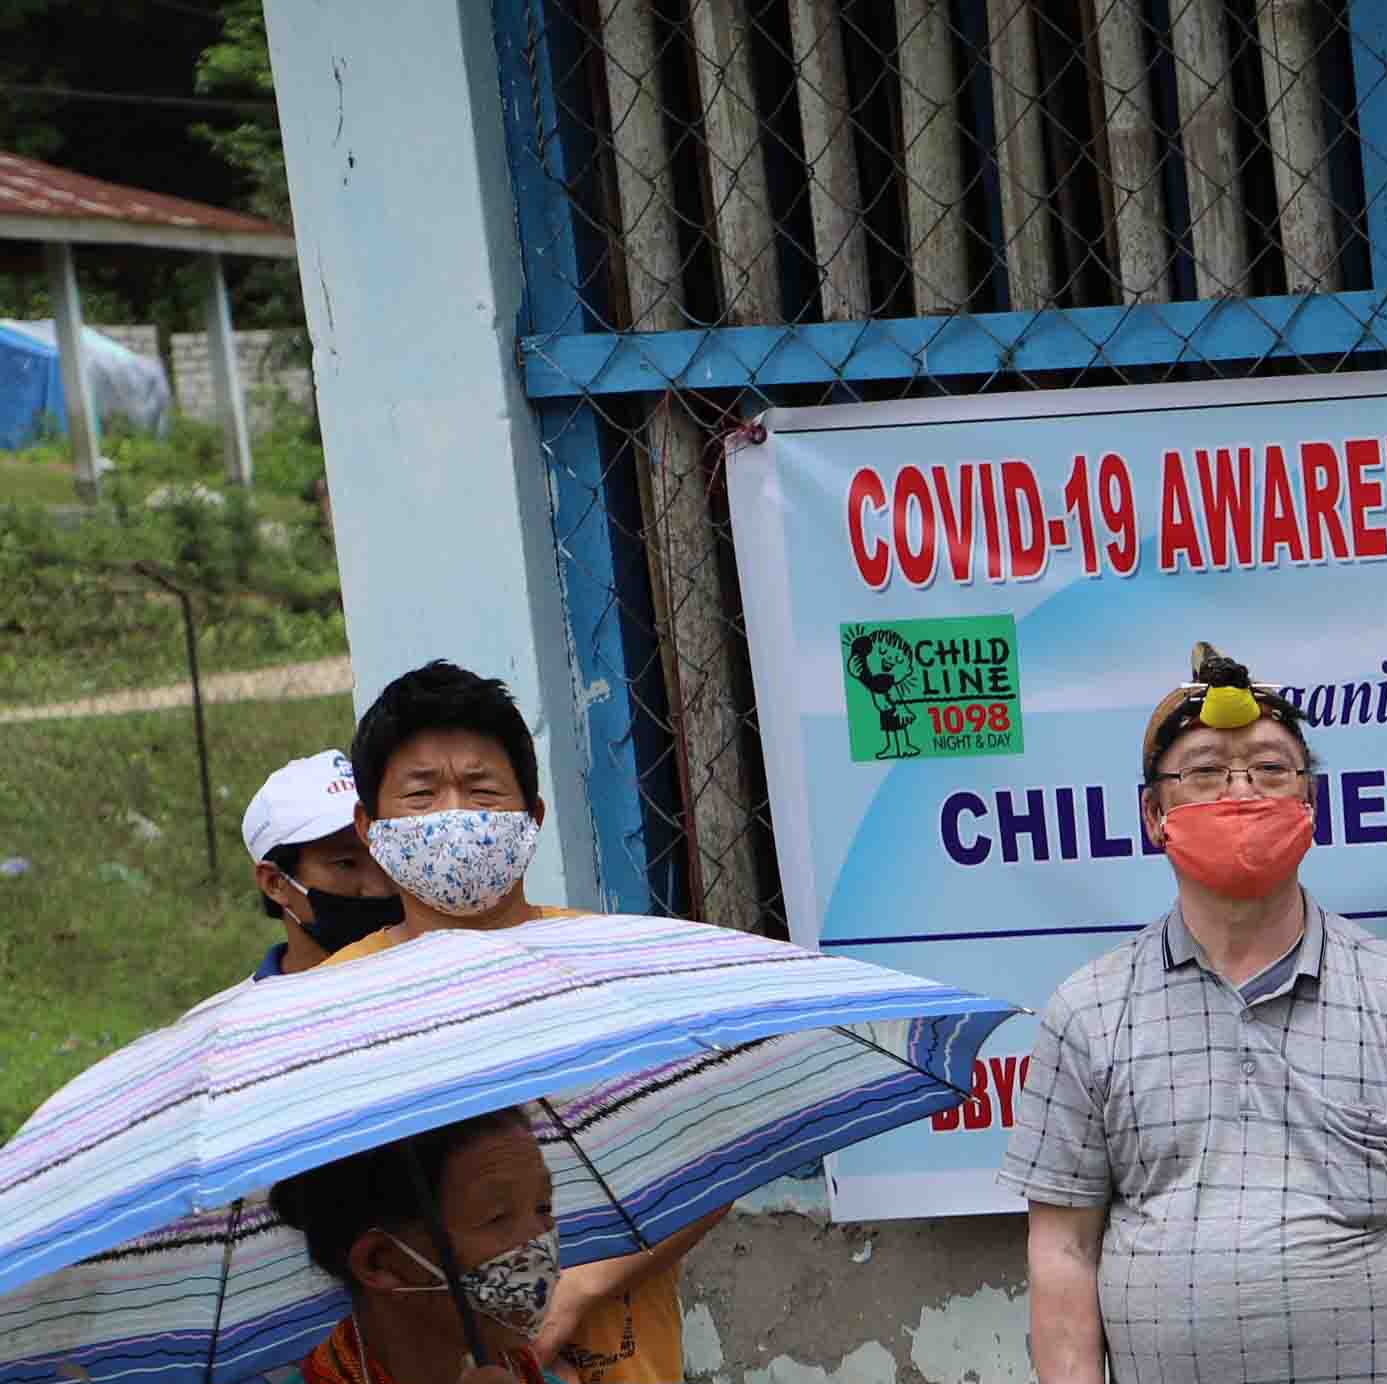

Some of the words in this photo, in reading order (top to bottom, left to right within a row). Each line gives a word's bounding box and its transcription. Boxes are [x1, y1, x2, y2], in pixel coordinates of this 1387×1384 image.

[847, 452, 1139, 589] COVID-19
[914, 637, 1010, 667] CHILD
[922, 666, 1011, 695] LINE
[927, 703, 1011, 735] 1098
[933, 736, 971, 750] NIGHT
[988, 732, 1012, 748] DAY
